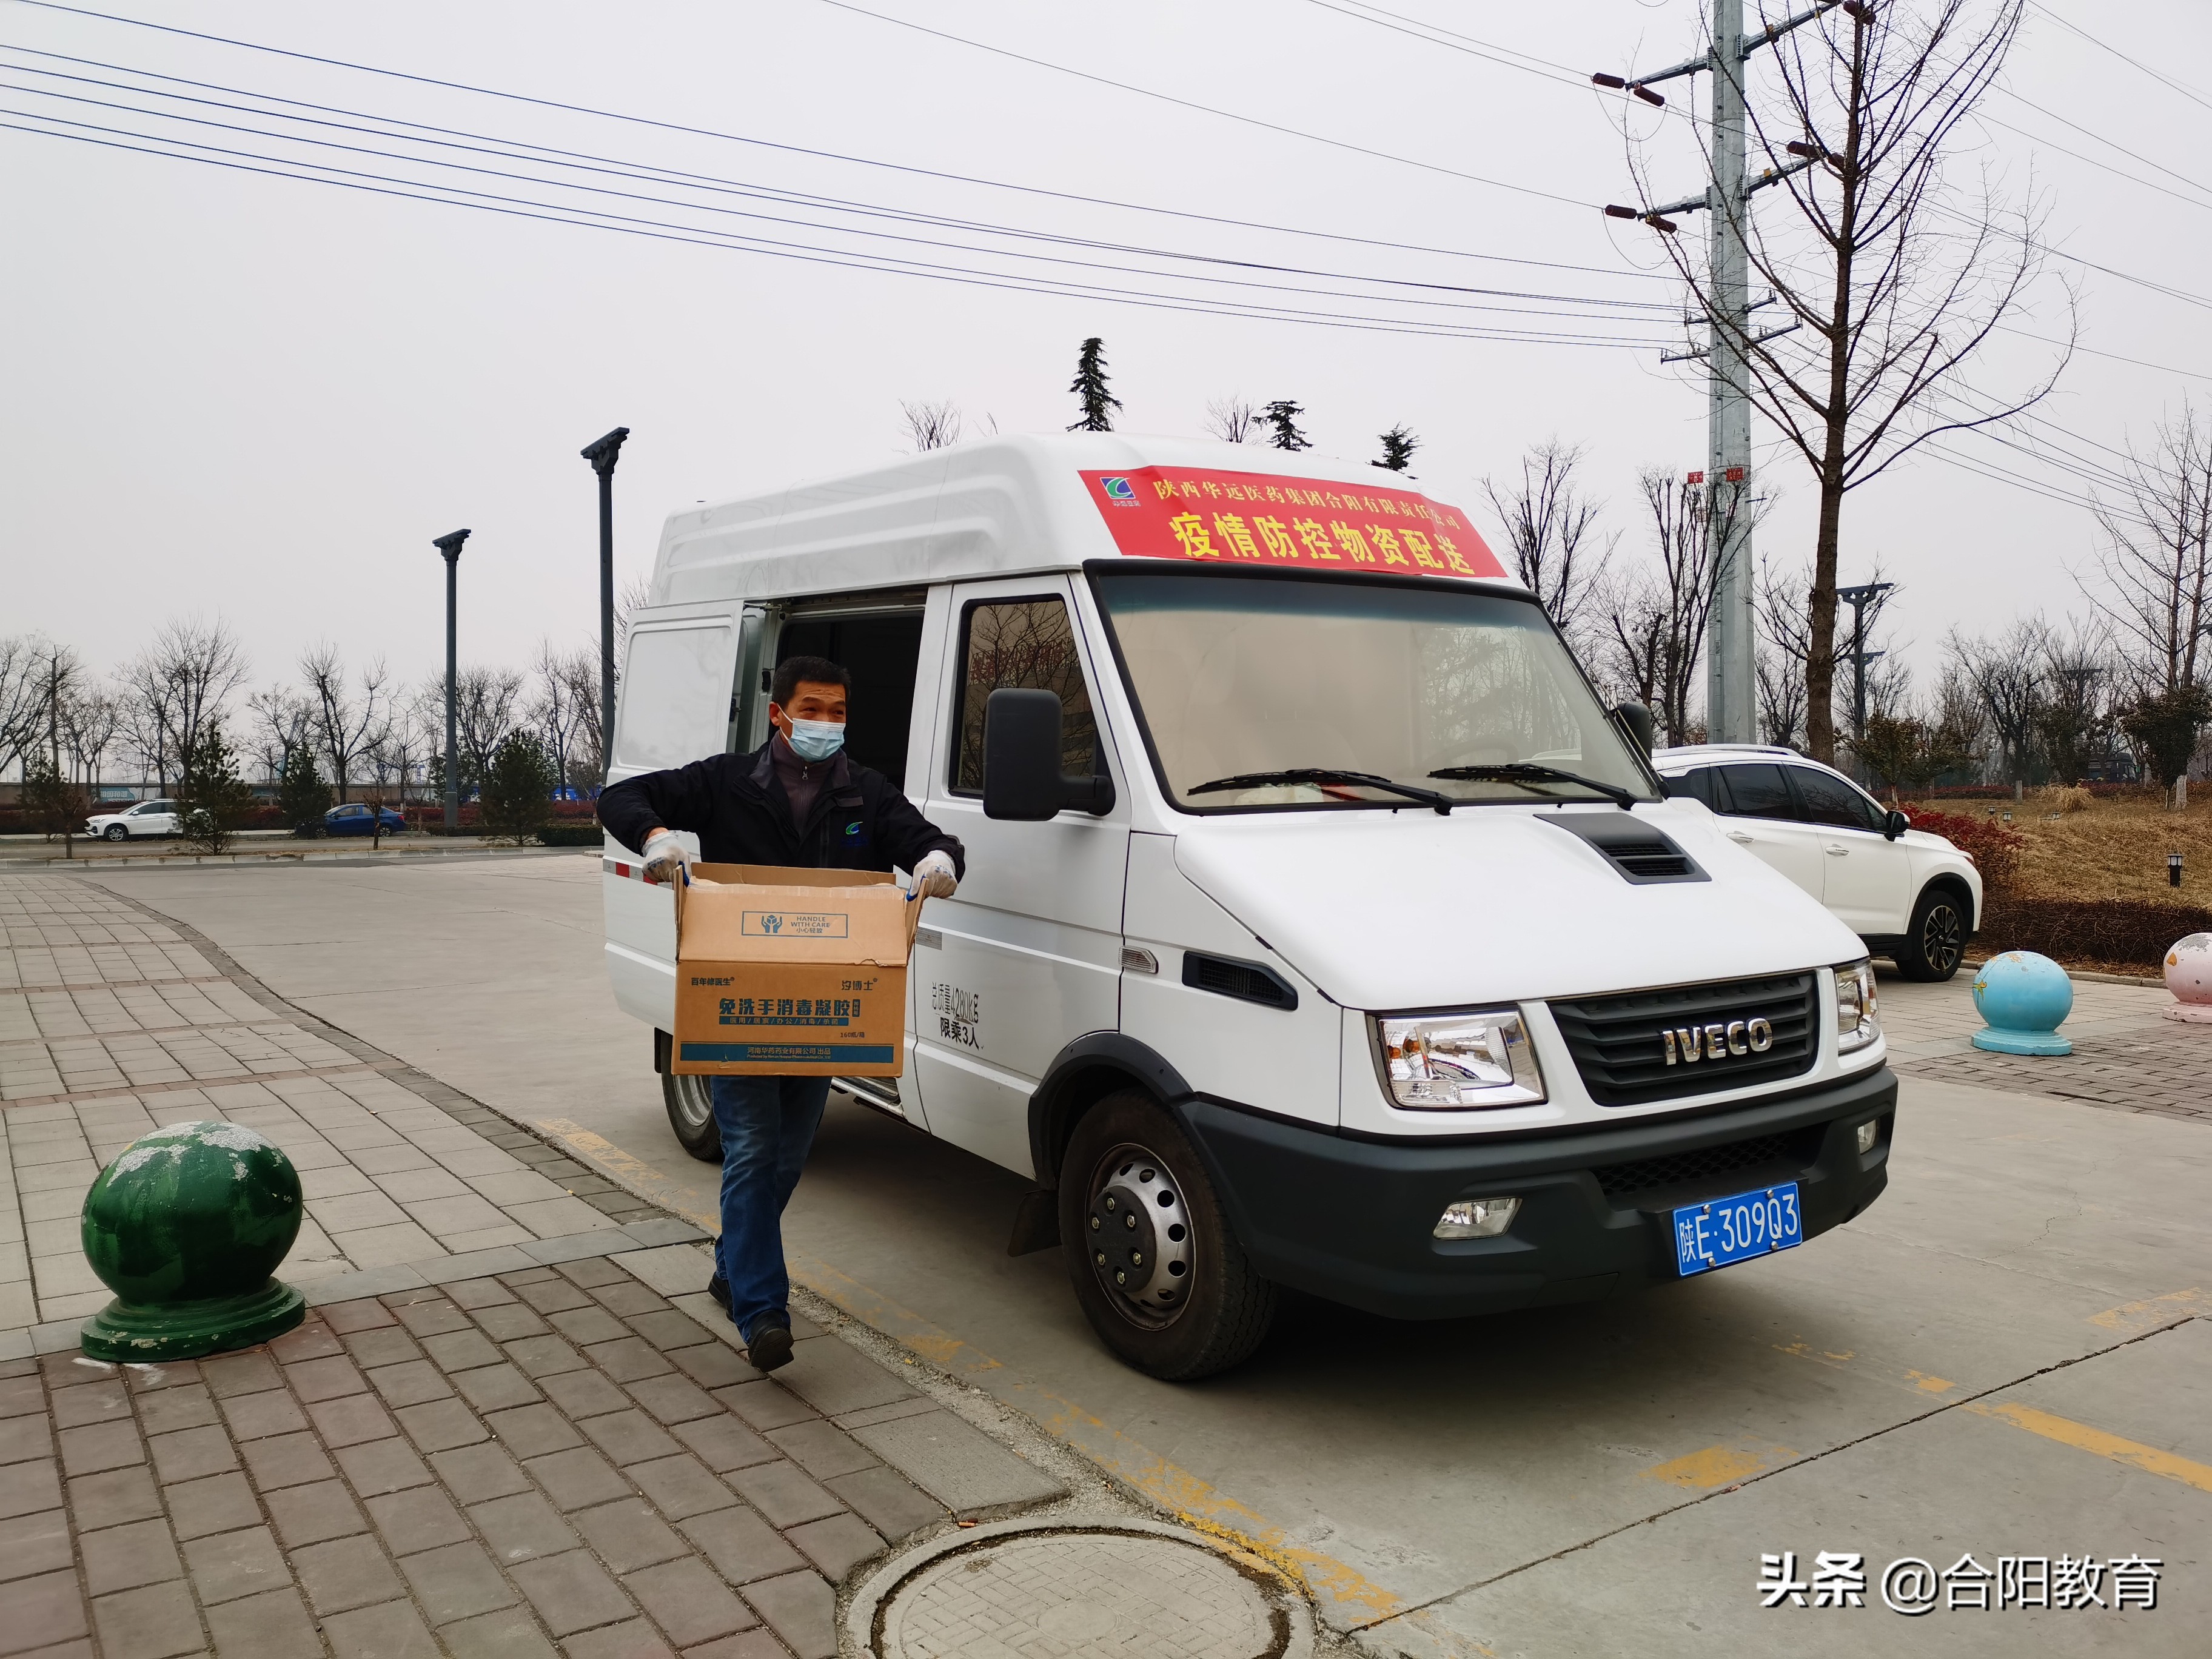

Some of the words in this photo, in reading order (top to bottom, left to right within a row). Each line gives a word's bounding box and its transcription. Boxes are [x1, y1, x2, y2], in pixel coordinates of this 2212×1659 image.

[1153, 478, 1461, 530] 陕西华远医药集团合阳有限责任公司
[1168, 511, 1475, 575] 疫情防控物资配送
[719, 997, 850, 1016] 免洗手消毒凝胶
[932, 981, 979, 1024] 总质量4280kg
[940, 1016, 979, 1051] 限乘3人
[1662, 1017, 1773, 1065] IVECO
